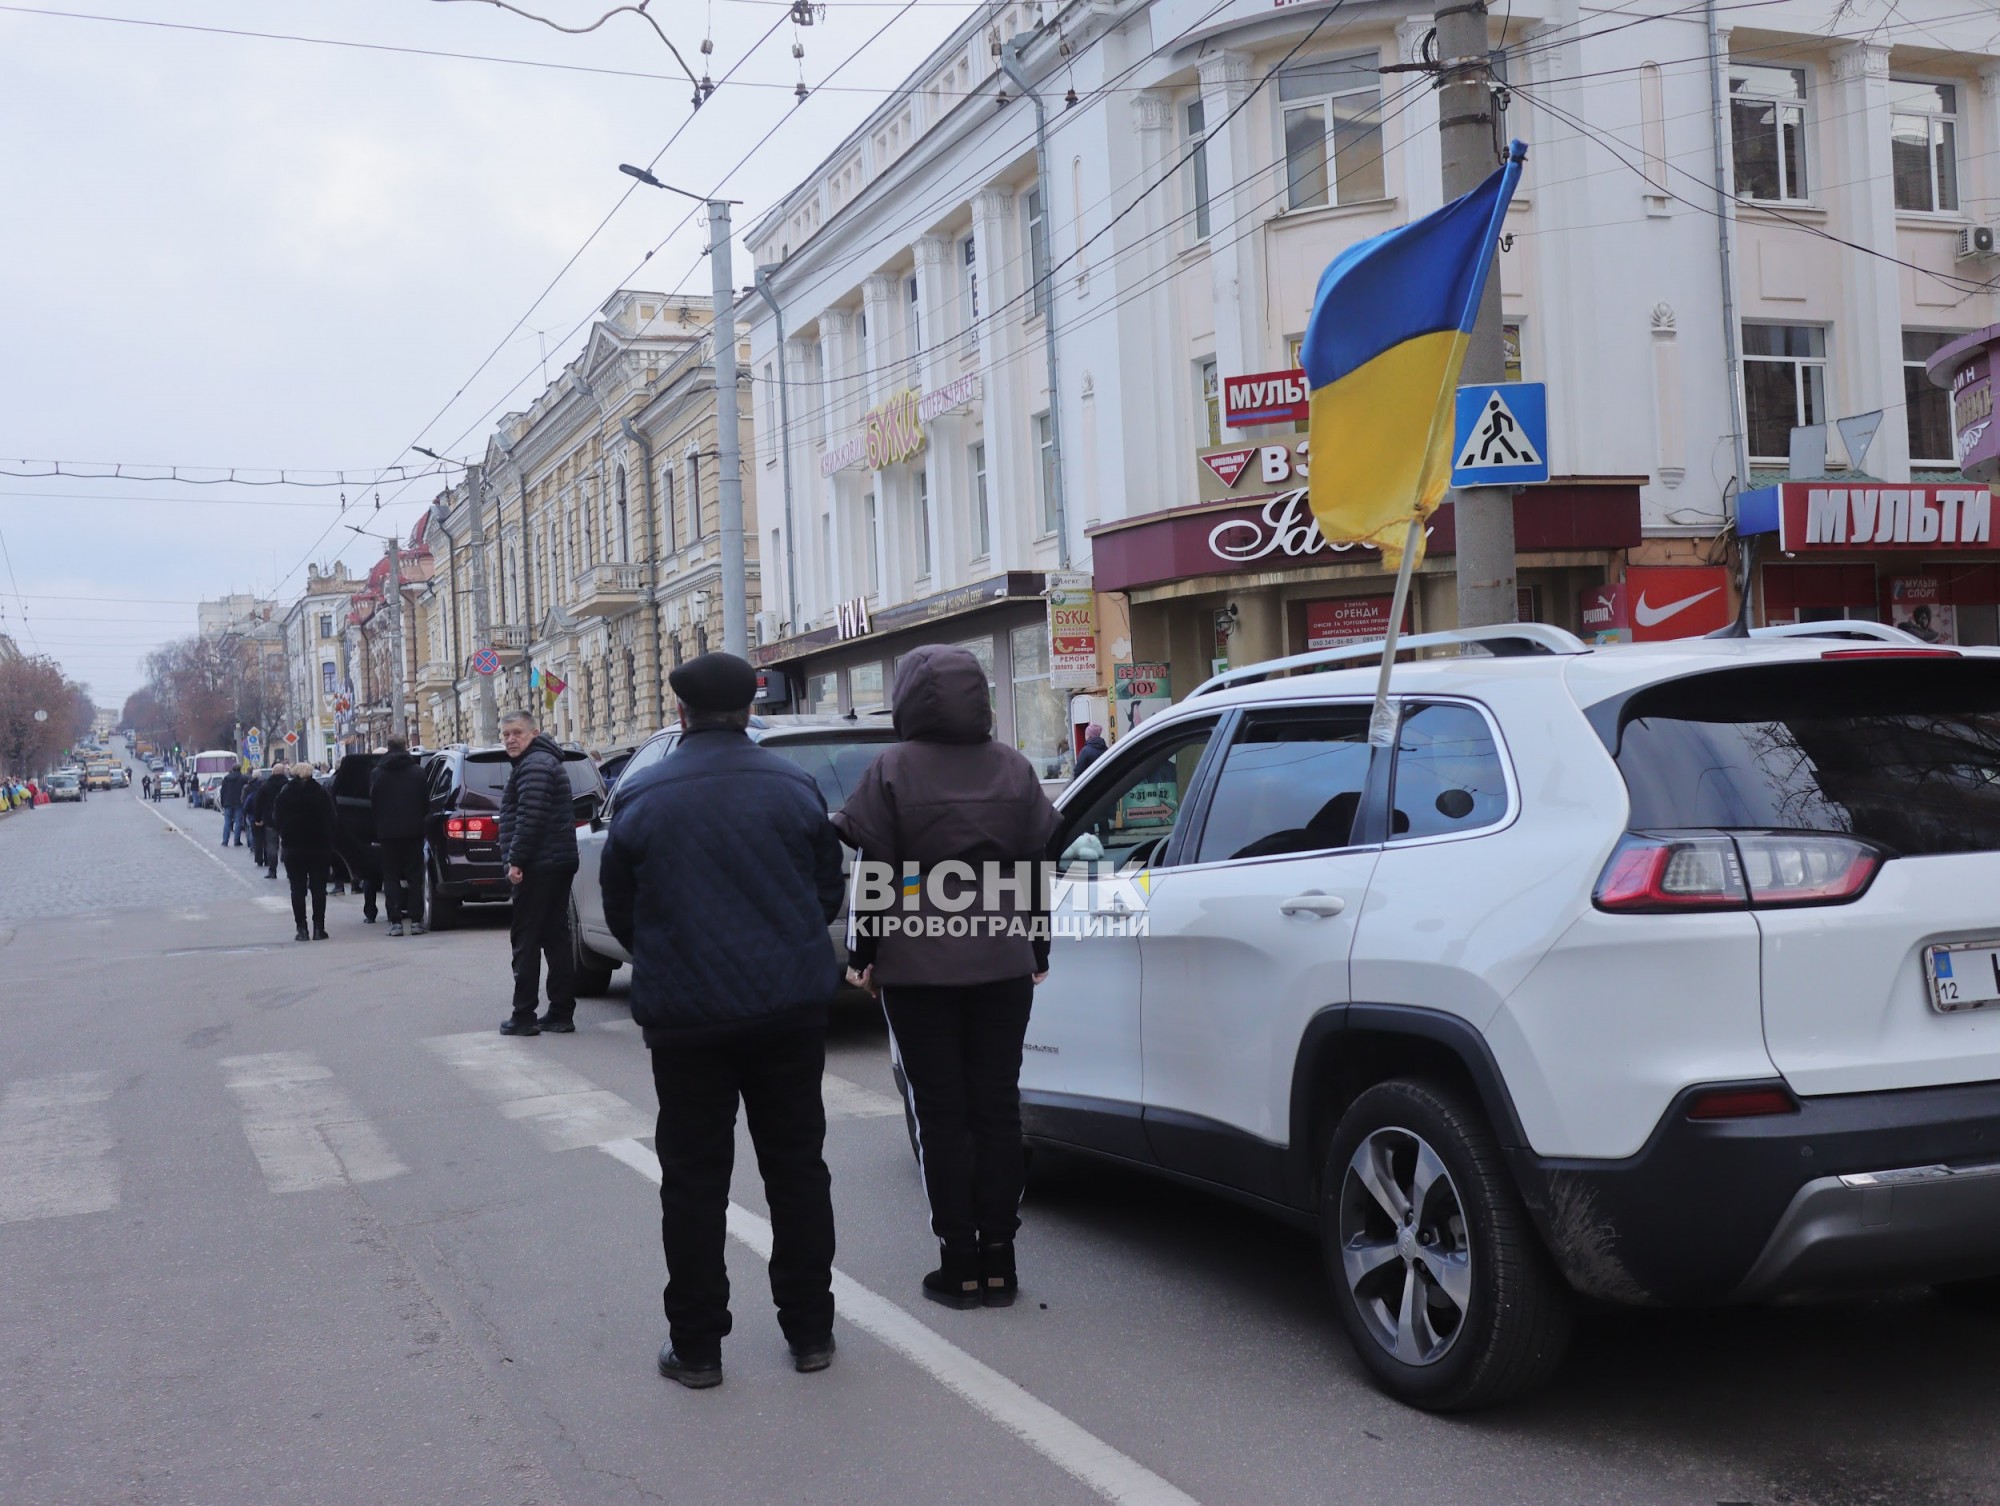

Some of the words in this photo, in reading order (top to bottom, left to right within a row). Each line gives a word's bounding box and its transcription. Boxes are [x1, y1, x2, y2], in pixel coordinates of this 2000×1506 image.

[918, 372, 974, 422] СУПЕРМАРКЕТ
[1229, 377, 1311, 410] МУЛЬТ
[1805, 489, 1991, 544] МУЛЬТИ
[1907, 588, 1936, 598] СПОРТ
[1335, 608, 1378, 618] ОРЕНДИ
[1583, 607, 1609, 624] PUMA
[1361, 625, 1389, 633] ТЕЛЕФОНО
[1080, 638, 1087, 647] 2
[1118, 665, 1167, 679] ВЗУТТЯ
[1131, 682, 1156, 694] JOY
[1940, 982, 1959, 1000] 12
